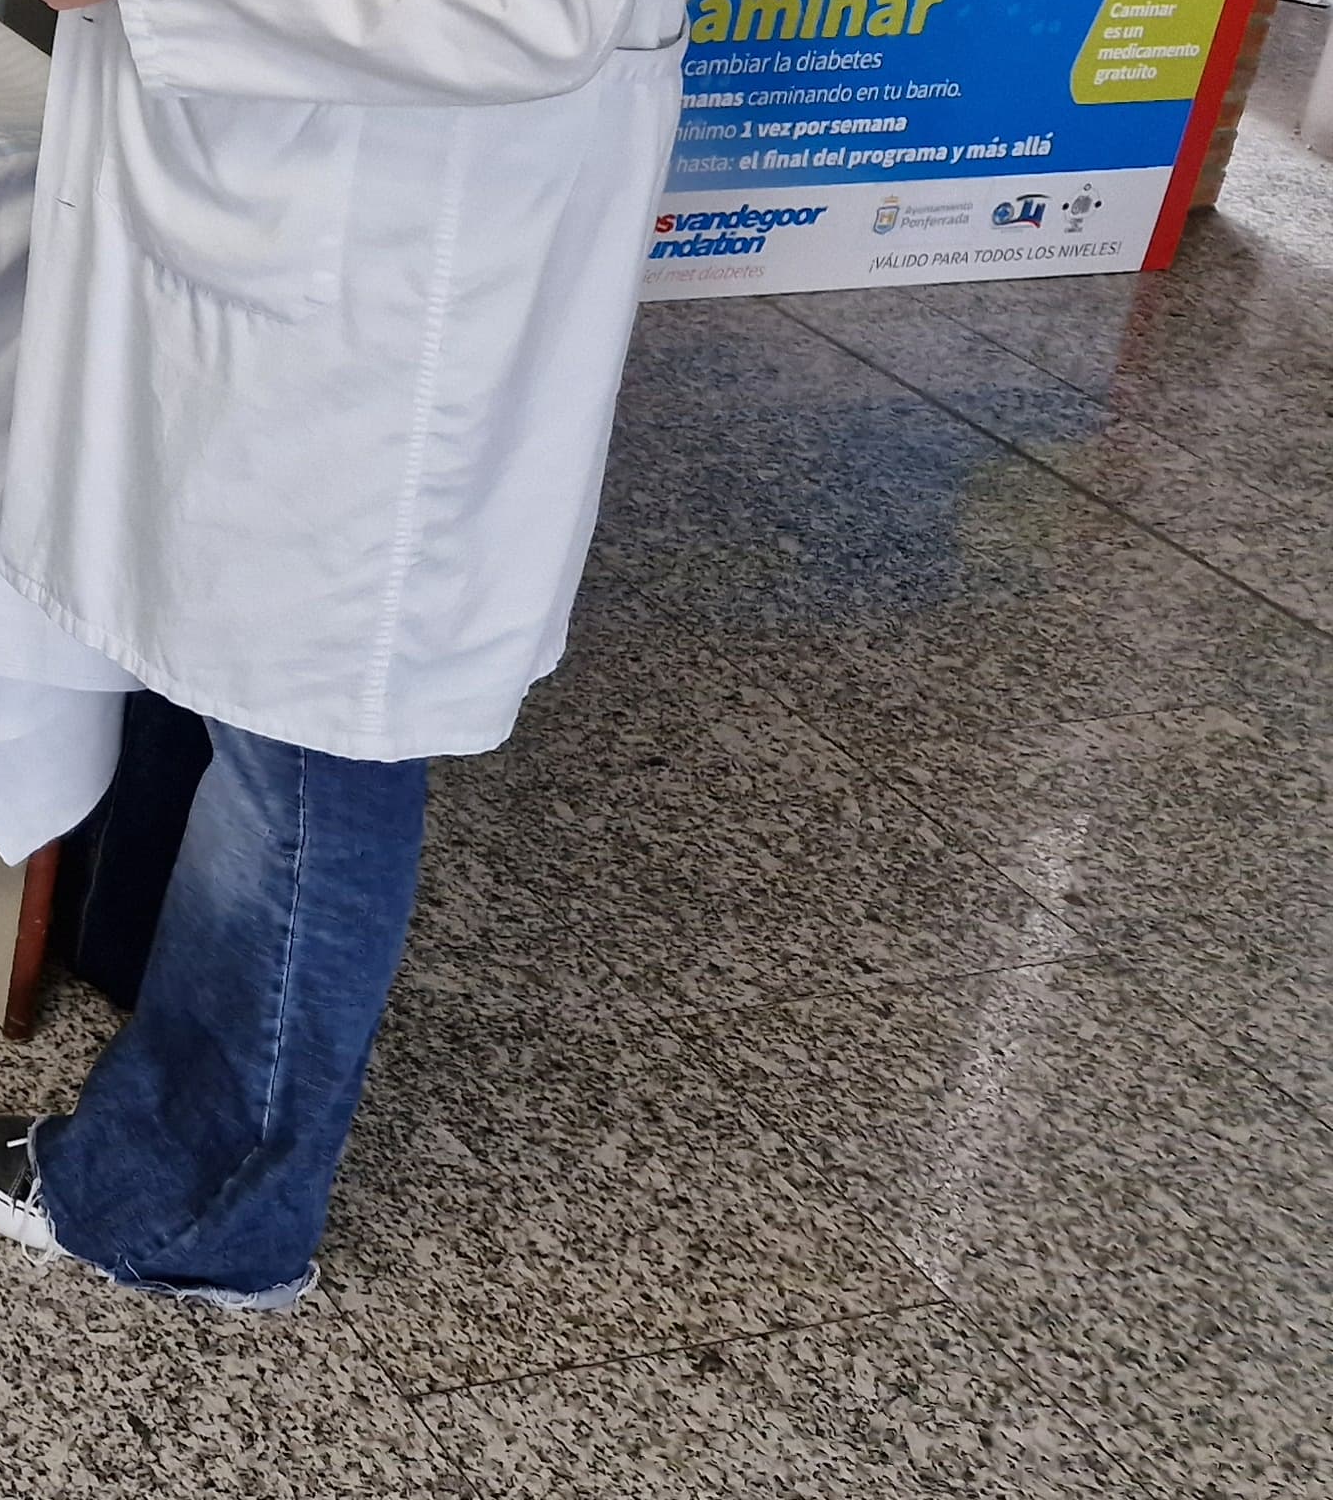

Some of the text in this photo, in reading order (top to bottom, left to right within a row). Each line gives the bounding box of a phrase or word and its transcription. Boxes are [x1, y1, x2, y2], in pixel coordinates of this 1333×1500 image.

[1110, 0, 1177, 18] Caminar
[1103, 25, 1144, 39] es un
[684, 50, 884, 77] cambiar la diabetes
[1097, 43, 1200, 61] medicamento
[1093, 63, 1158, 86] gratuito
[682, 78, 962, 109] manas caminando en tu barrio.
[739, 121, 753, 139] 1
[757, 122, 790, 138] vez
[793, 120, 831, 140] por
[830, 115, 907, 135] semana
[676, 132, 1054, 172] hasta: el final del programa y más allá
[900, 212, 970, 230] Ponferrada
[869, 240, 1122, 273] ¡VÁLIDO PARA TODOS LOS NIVELES!
[698, 263, 765, 281] diabetes
